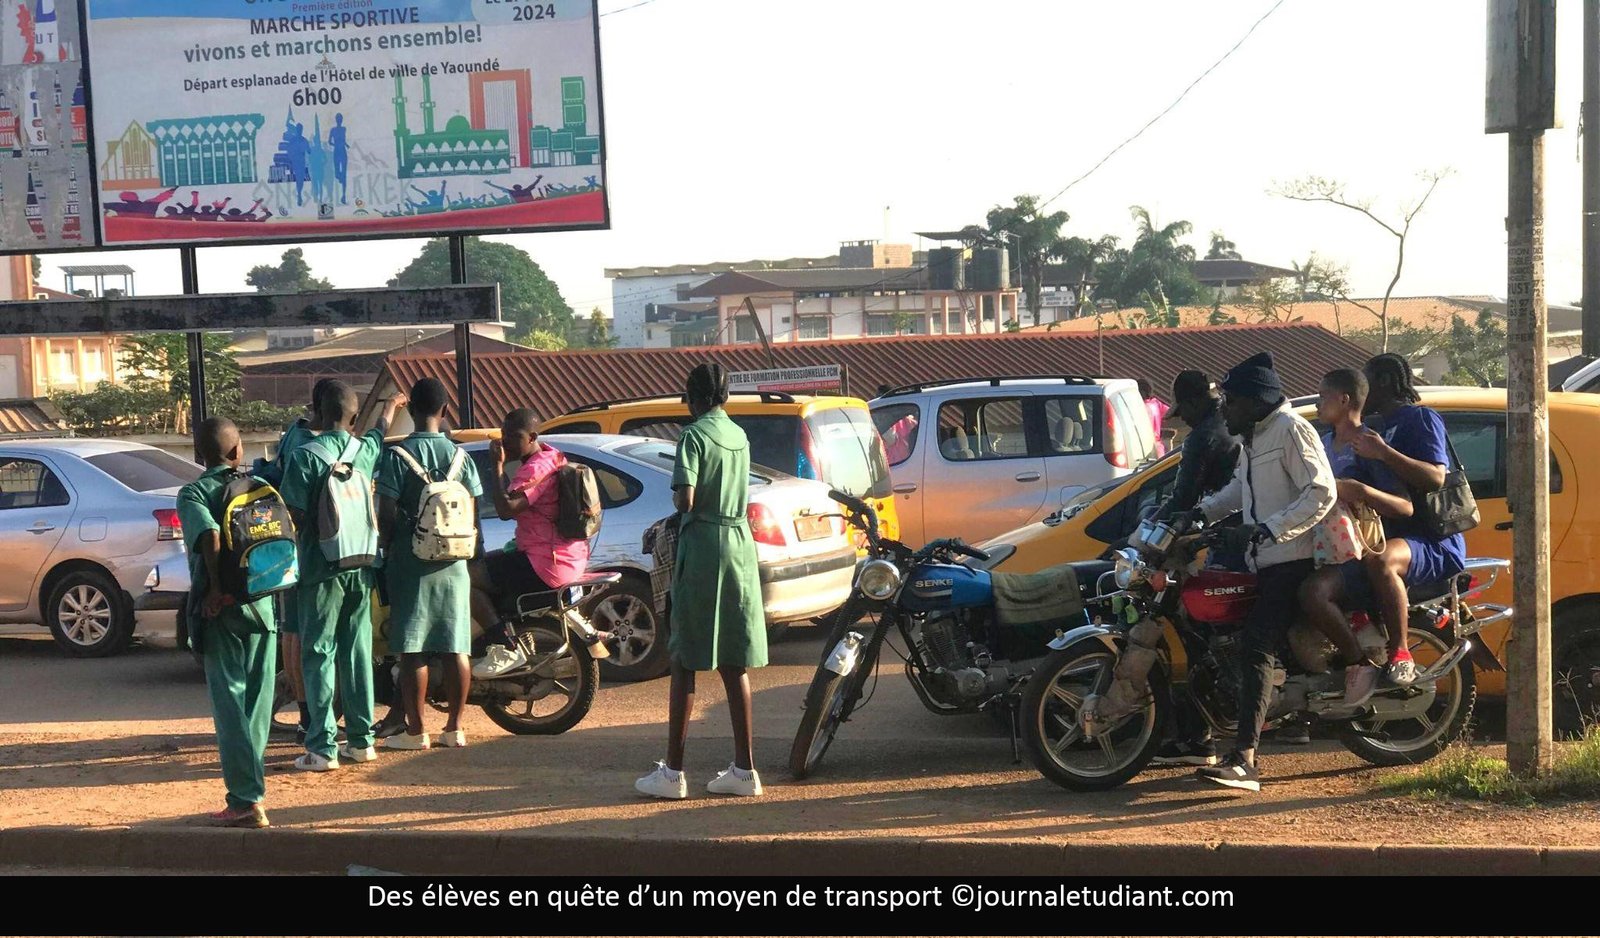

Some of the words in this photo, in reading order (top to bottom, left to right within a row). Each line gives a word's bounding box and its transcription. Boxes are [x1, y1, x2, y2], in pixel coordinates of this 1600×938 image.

[292, 3, 335, 12] Première
[512, 4, 556, 21] 2024
[250, 15, 326, 35] MARCHE
[330, 7, 420, 28] SPORTIVE
[183, 44, 246, 63] vivons
[251, 41, 270, 58] et
[276, 34, 372, 56] marchons
[377, 24, 482, 50] ensemble!
[183, 77, 227, 93] Départ
[231, 72, 297, 90] esplanade
[301, 71, 317, 84] de
[369, 65, 386, 80] de
[389, 65, 417, 78] ville
[421, 62, 437, 76] de
[440, 57, 500, 74] Yaoundé
[292, 87, 342, 107] 6h00
[743, 373, 750, 383] DE
[750, 371, 780, 382] FORMATION
[780, 368, 825, 380] PROFESSIONNELLE
[915, 578, 954, 588] SENKE
[1204, 585, 1245, 596] SENKE
